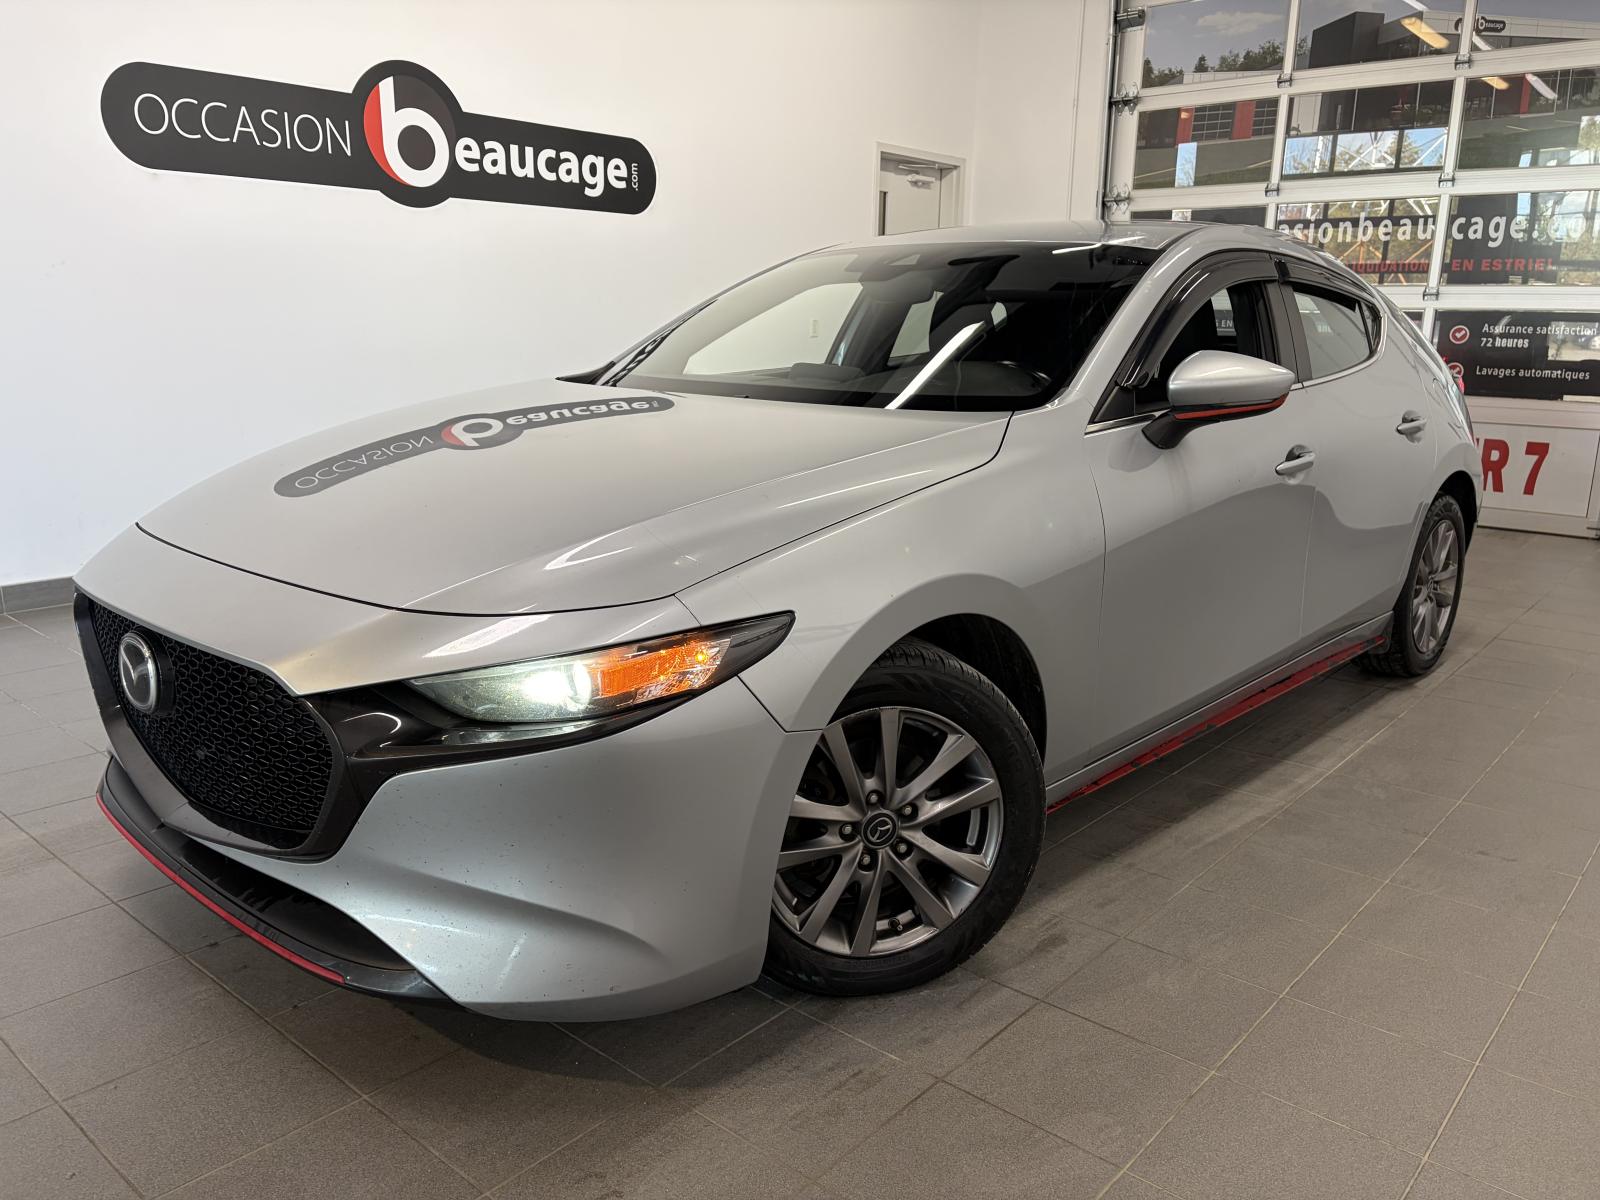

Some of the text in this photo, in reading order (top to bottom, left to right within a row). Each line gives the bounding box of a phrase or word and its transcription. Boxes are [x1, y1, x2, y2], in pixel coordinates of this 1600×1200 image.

[134, 75, 628, 198] OCCASION beaucage
[1451, 258, 1475, 272] EN
[1482, 323, 1598, 337] Assurance satisfaction
[1480, 336, 1530, 349] 72 heures
[1475, 365, 1591, 381] Lavages automatiques
[1476, 438, 1550, 496] R 7
